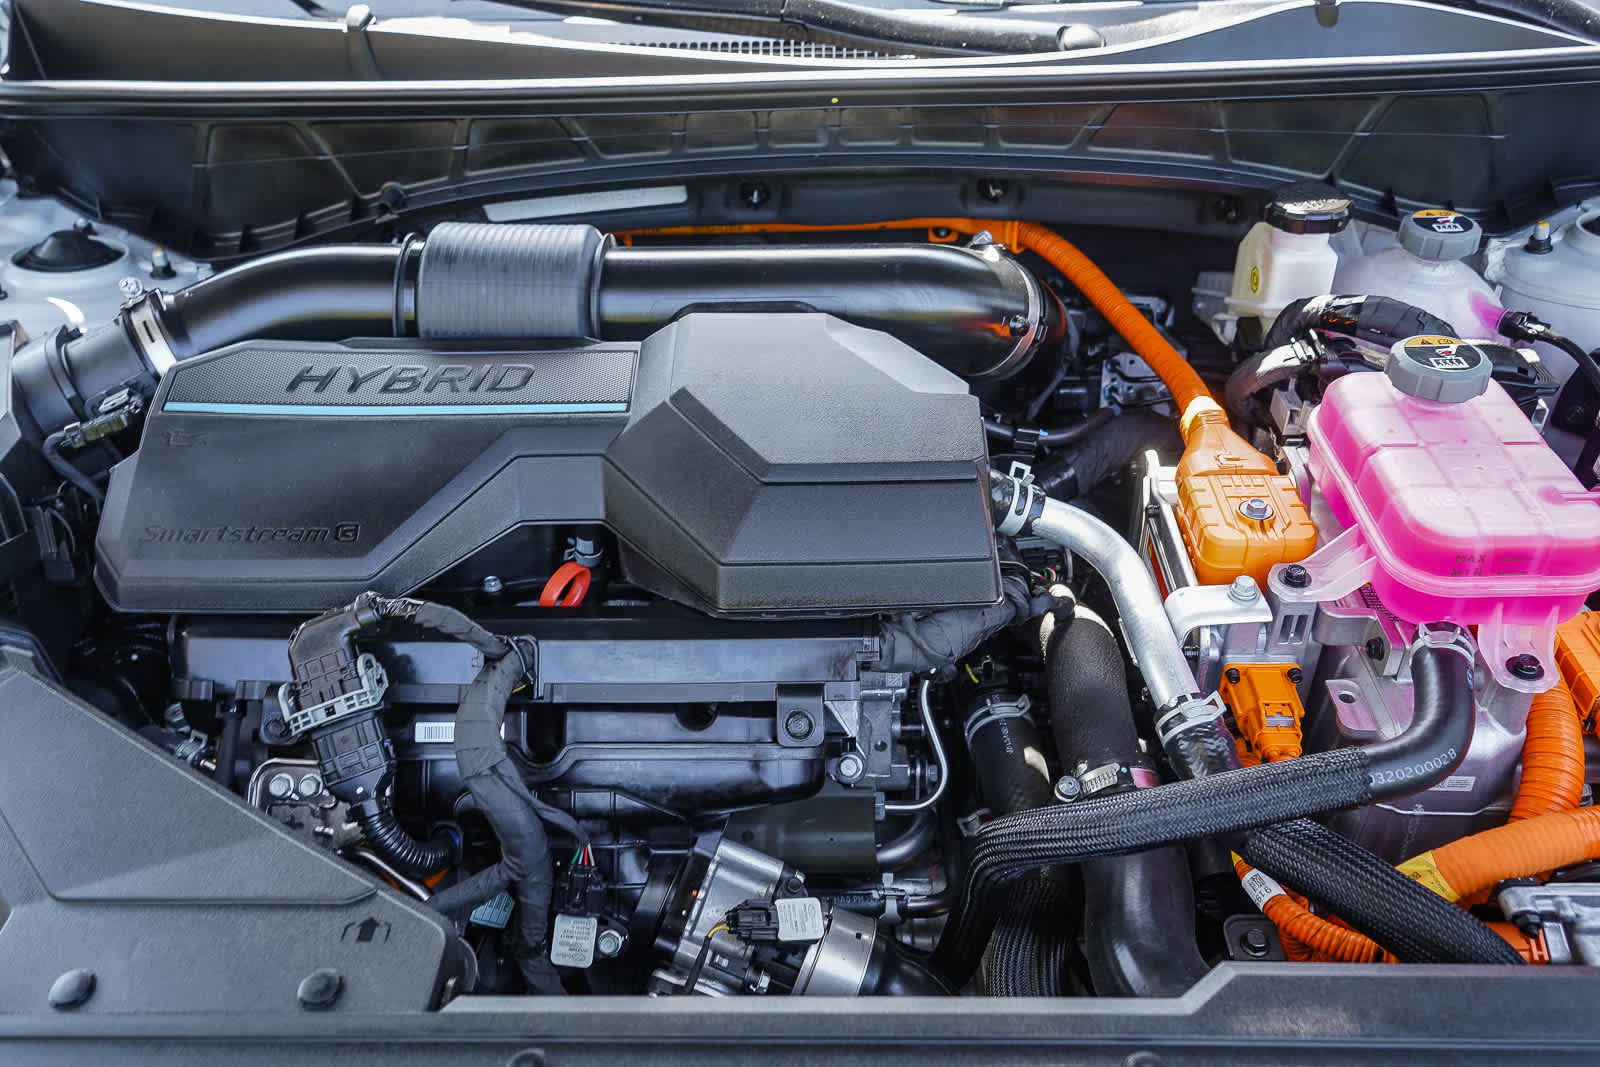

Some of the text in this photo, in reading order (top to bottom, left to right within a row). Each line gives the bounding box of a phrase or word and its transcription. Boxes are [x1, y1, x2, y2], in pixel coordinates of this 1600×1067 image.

[286, 364, 536, 394] HYBRID
[143, 524, 331, 544] Smartstream
[1455, 553, 1488, 564] MAX
[1451, 567, 1482, 577] MIN
